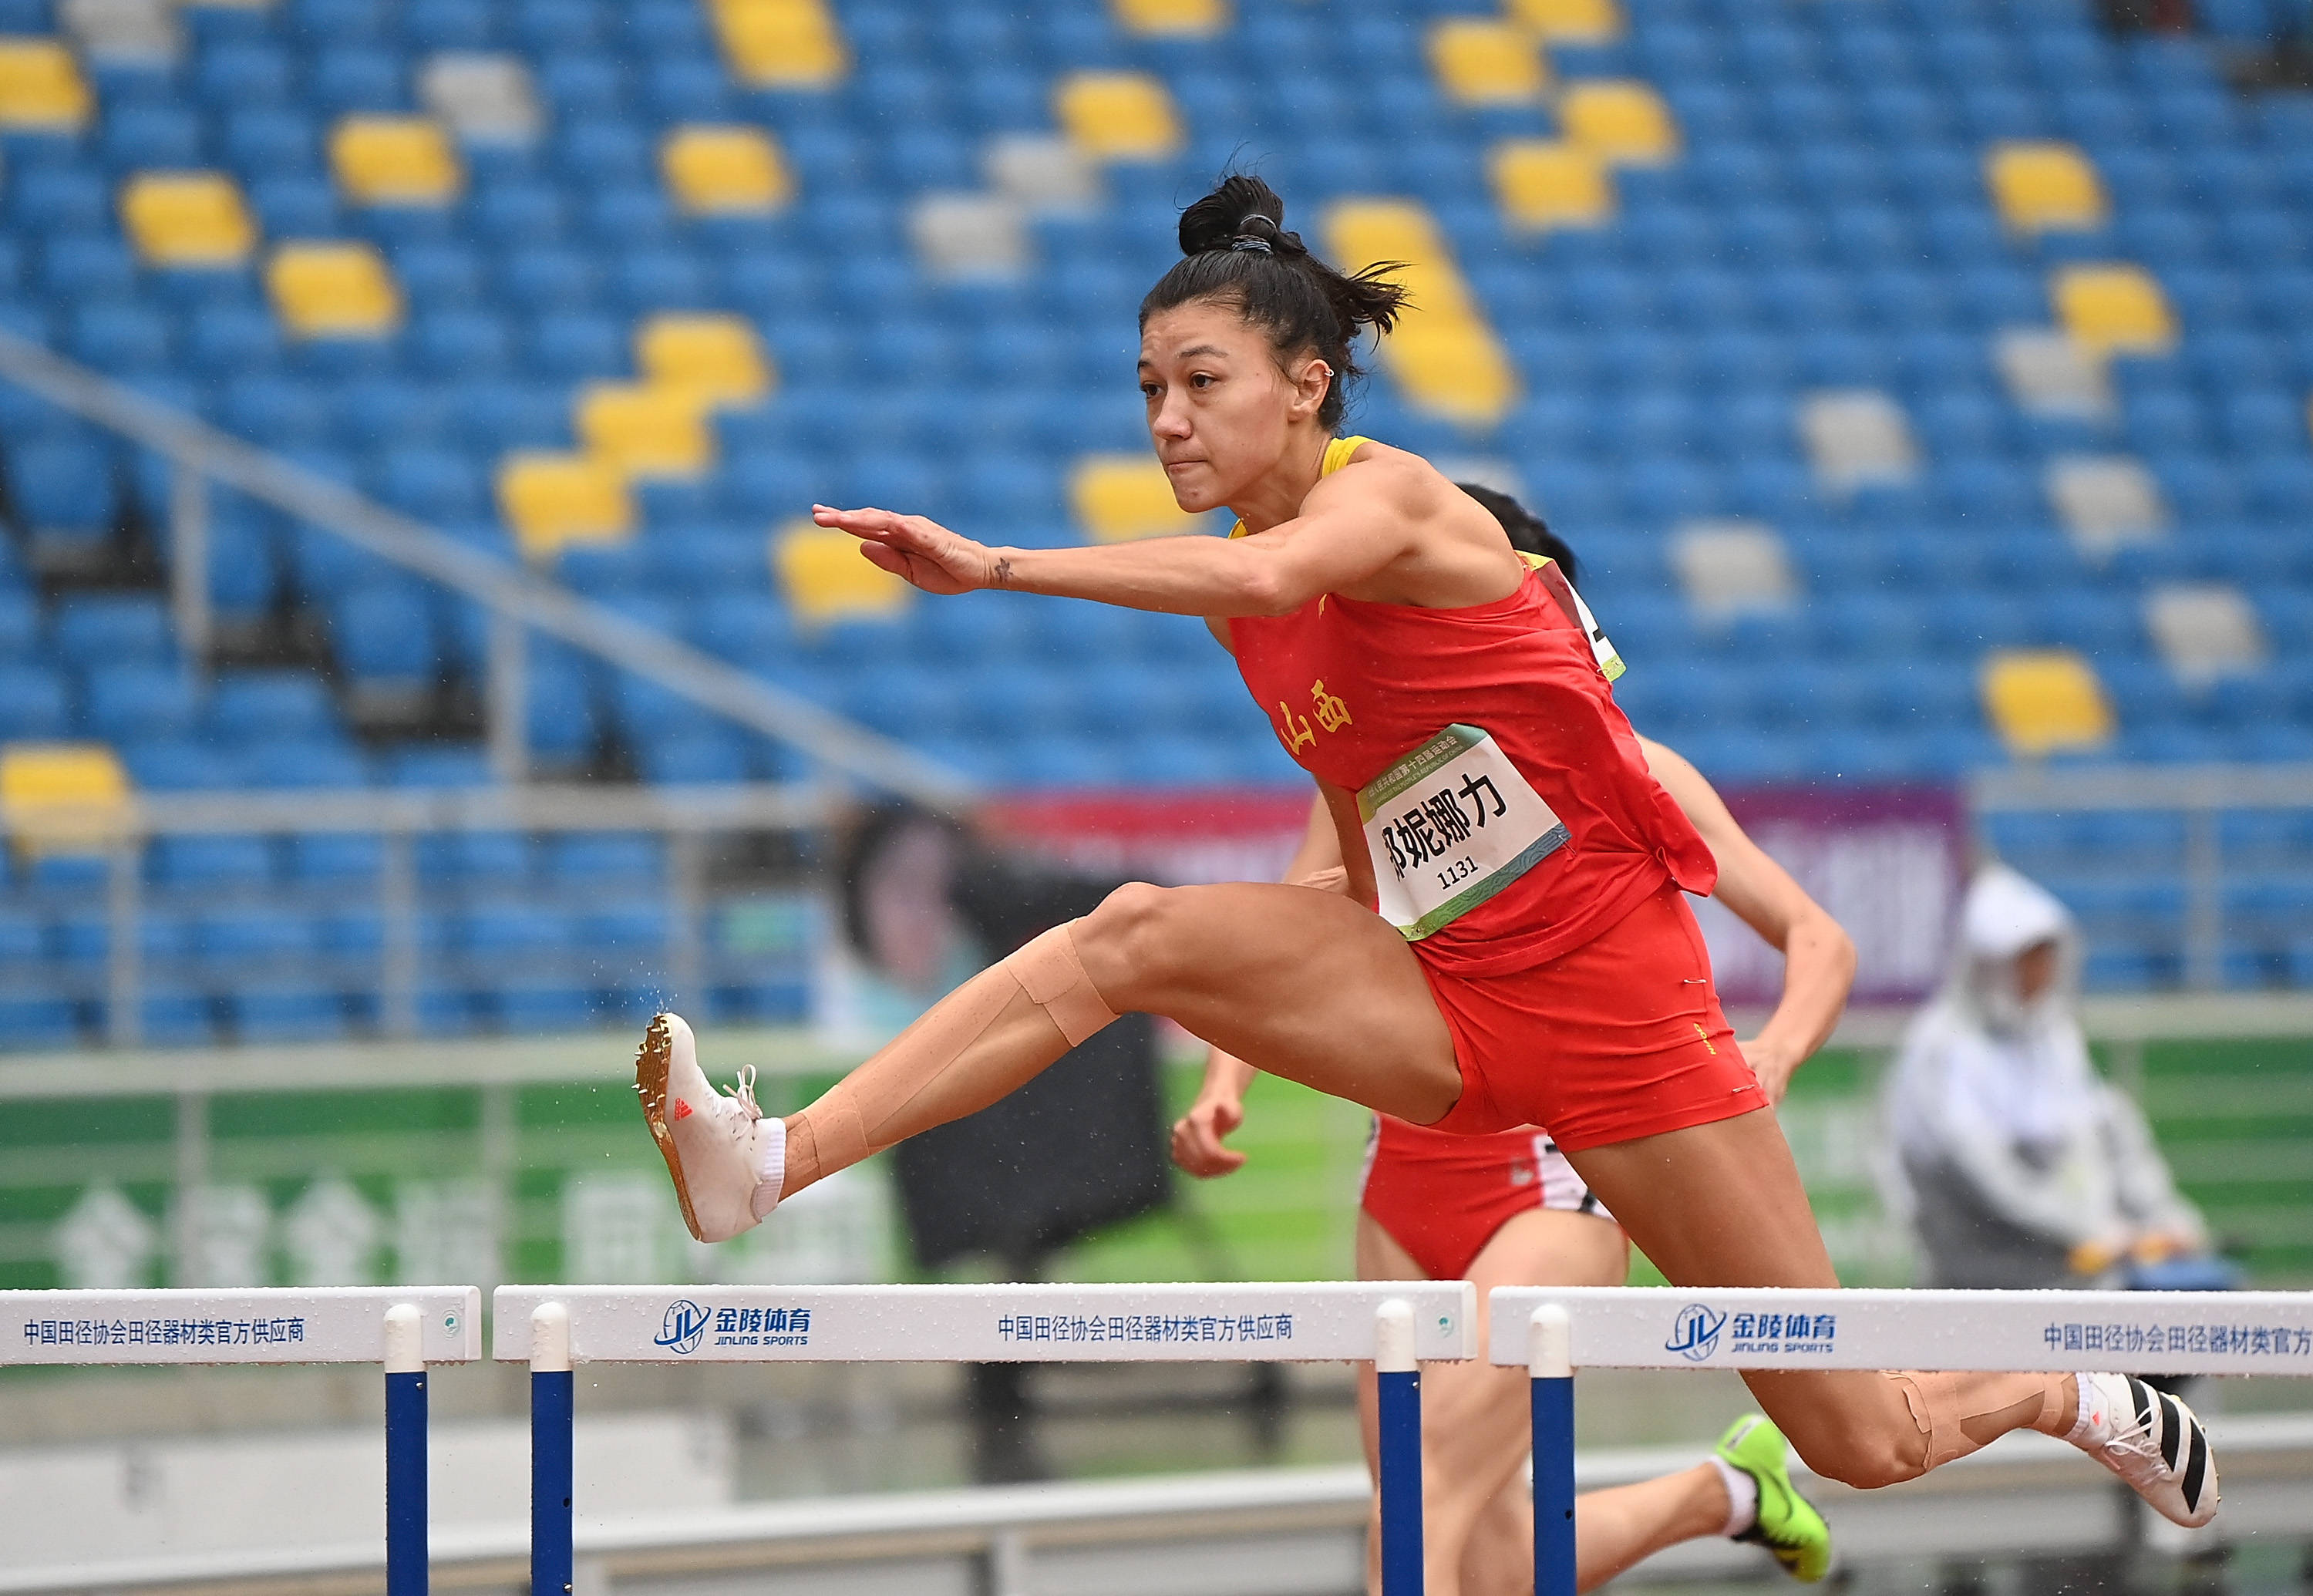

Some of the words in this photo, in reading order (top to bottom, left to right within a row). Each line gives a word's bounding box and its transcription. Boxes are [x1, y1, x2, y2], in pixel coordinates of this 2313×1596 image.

[1280, 679, 1352, 756] 山西
[1437, 856, 1479, 890] 1131
[24, 1317, 305, 1345] 中国田径协会田径器材类官方供应商
[715, 1308, 811, 1332] 金陵体育
[998, 1313, 1293, 1342] 中国田径协会田径器材类官方供应商
[1732, 1313, 1837, 1340] 金陵体育
[714, 1335, 759, 1345] JINLING
[763, 1335, 809, 1345] SPORTS
[1732, 1342, 1779, 1353] JINLING
[1784, 1342, 1834, 1354] SPORTS
[2044, 1322, 2312, 1355] 中国田径协会田径器材类官方
